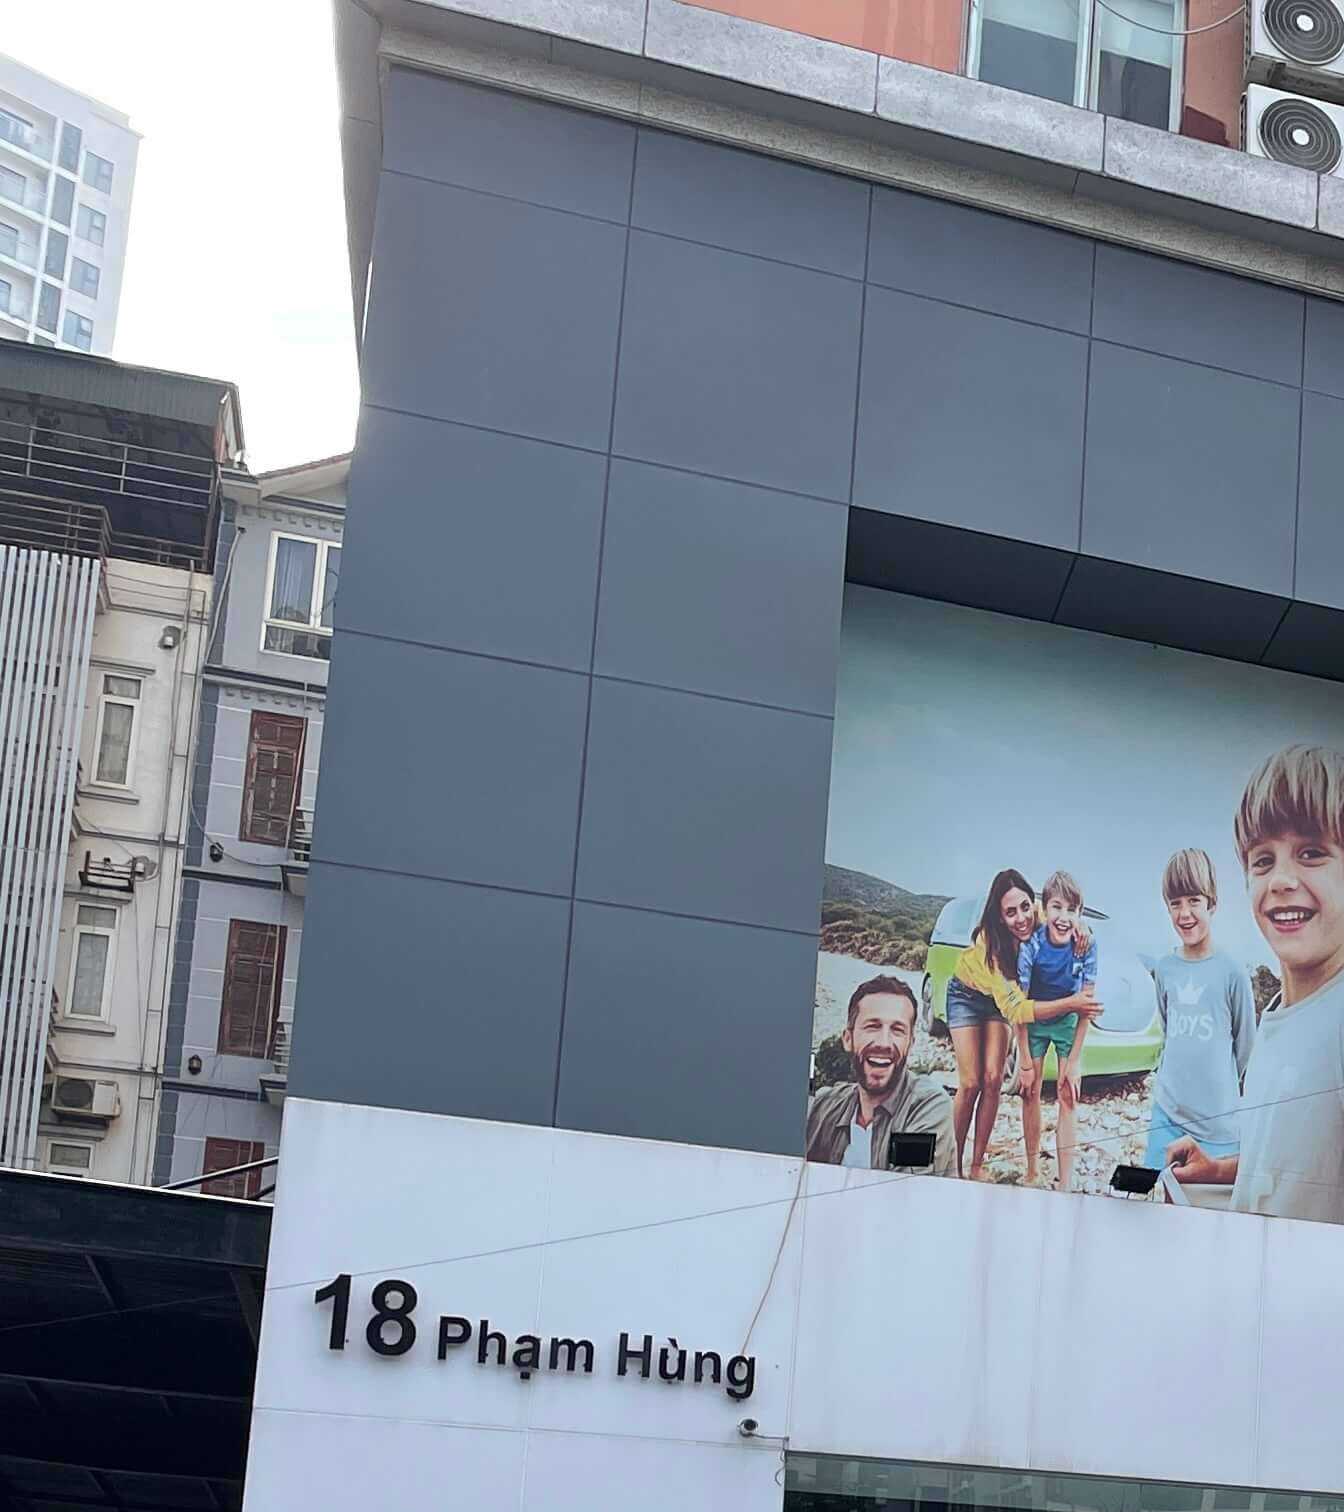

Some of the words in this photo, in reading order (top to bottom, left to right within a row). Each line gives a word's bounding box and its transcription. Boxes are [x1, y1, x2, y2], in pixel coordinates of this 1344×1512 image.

[314, 1274, 418, 1357] 18
[437, 1316, 595, 1381] Phạm
[617, 1332, 756, 1399] Hùng
